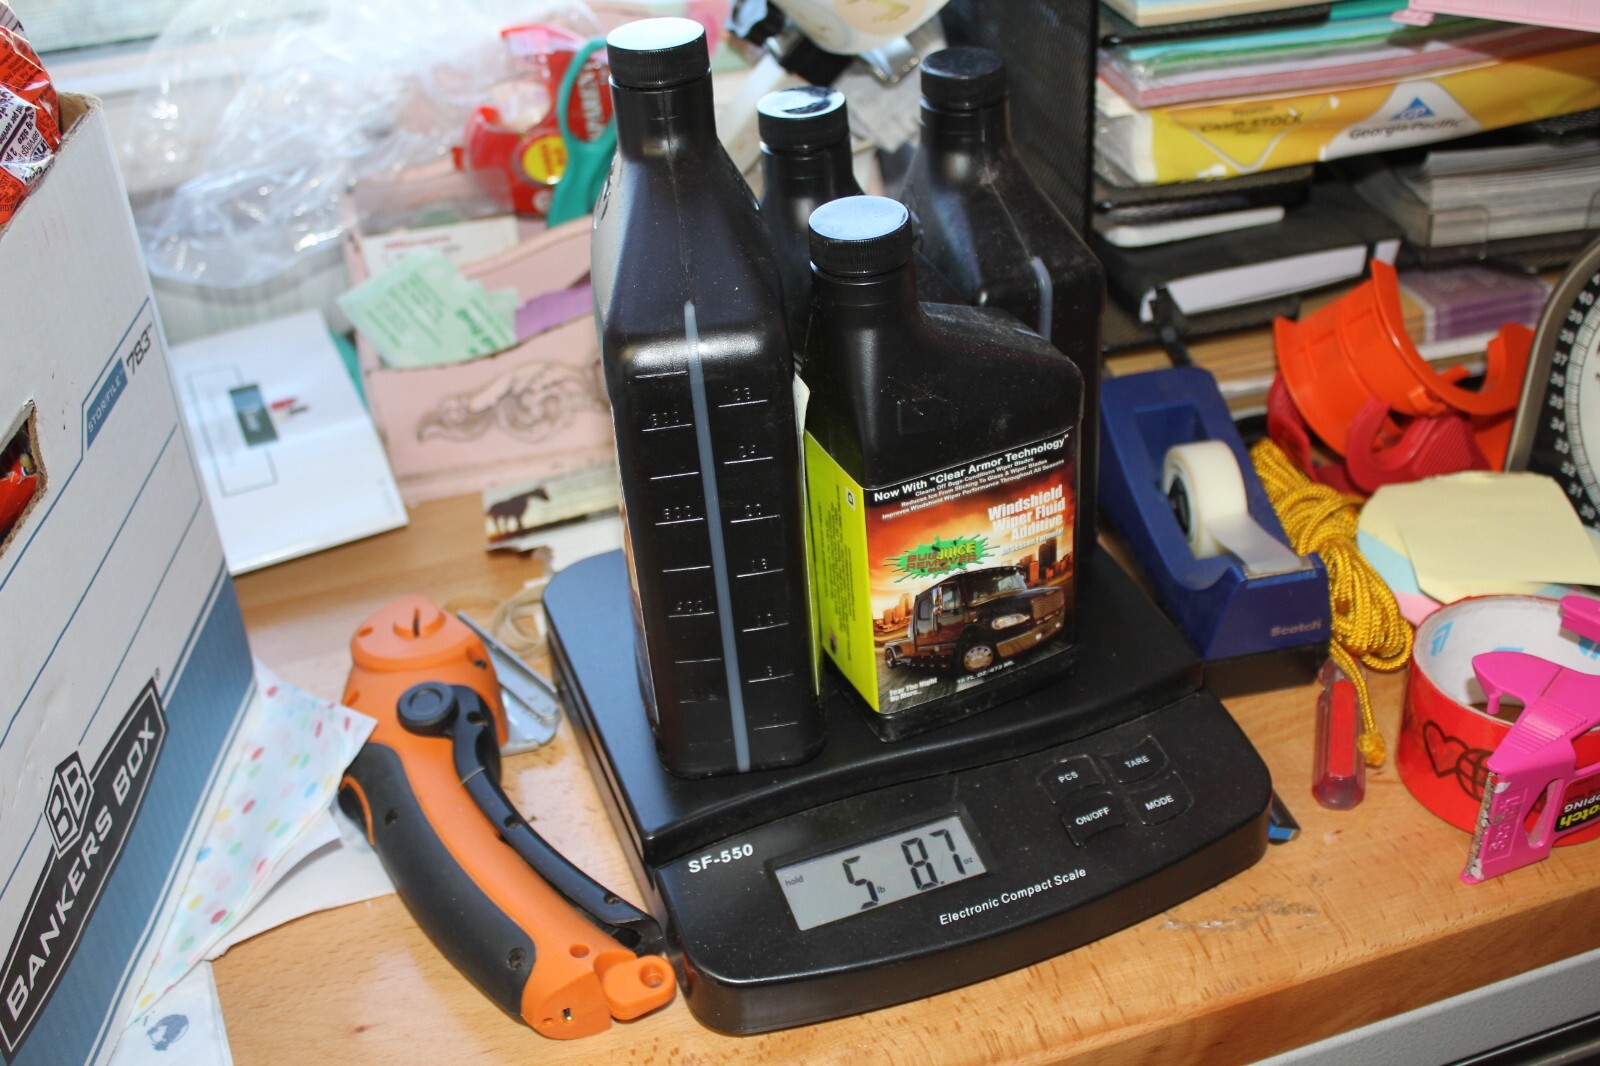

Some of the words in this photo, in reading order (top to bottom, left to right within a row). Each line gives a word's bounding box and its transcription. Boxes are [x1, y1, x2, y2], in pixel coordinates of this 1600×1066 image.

[126, 330, 151, 376] 783
[874, 489, 899, 502] Now
[902, 480, 927, 494] With
[930, 469, 966, 484] "Clear
[968, 458, 1003, 474] Armor
[1005, 434, 1069, 462] Technology"
[901, 496, 927, 507] Reduces
[939, 488, 954, 496] From
[955, 480, 978, 491] Sticking
[987, 473, 1004, 481] Glass
[1010, 466, 1027, 474] Wiper
[1028, 459, 1048, 468] Blades
[915, 487, 935, 497] Cleans
[996, 464, 1013, 472] Wiper
[1014, 457, 1034, 466] Blades
[882, 509, 909, 520] Improves
[911, 499, 943, 511] Windshield
[944, 493, 961, 501] Wiper
[962, 481, 1000, 495] Performance
[1000, 471, 1032, 484] Throughout
[1042, 459, 1064, 471] Seasons
[988, 484, 1063, 521] Windshield
[992, 511, 1034, 533] Wiper
[1035, 497, 1066, 520] Fluid
[1011, 514, 1063, 542] Additive
[936, 541, 976, 560] JUICE
[1270, 619, 1323, 637] Scotch
[1058, 771, 1078, 783] PCS
[1124, 755, 1150, 768] TARE
[1075, 806, 1110, 825] ON/OFF
[1144, 795, 1174, 810] MODE
[1560, 803, 1600, 827] otch
[7, 804, 114, 1022] BANKERS
[111, 716, 157, 808] BOX
[688, 842, 754, 874] SF-550
[785, 874, 804, 887] hold
[842, 855, 880, 910] 5
[877, 885, 886, 894] lb
[963, 856, 973, 865] oz
[939, 896, 999, 926] Electronic
[1000, 878, 1053, 907] Compact
[1054, 867, 1087, 890] Scale
